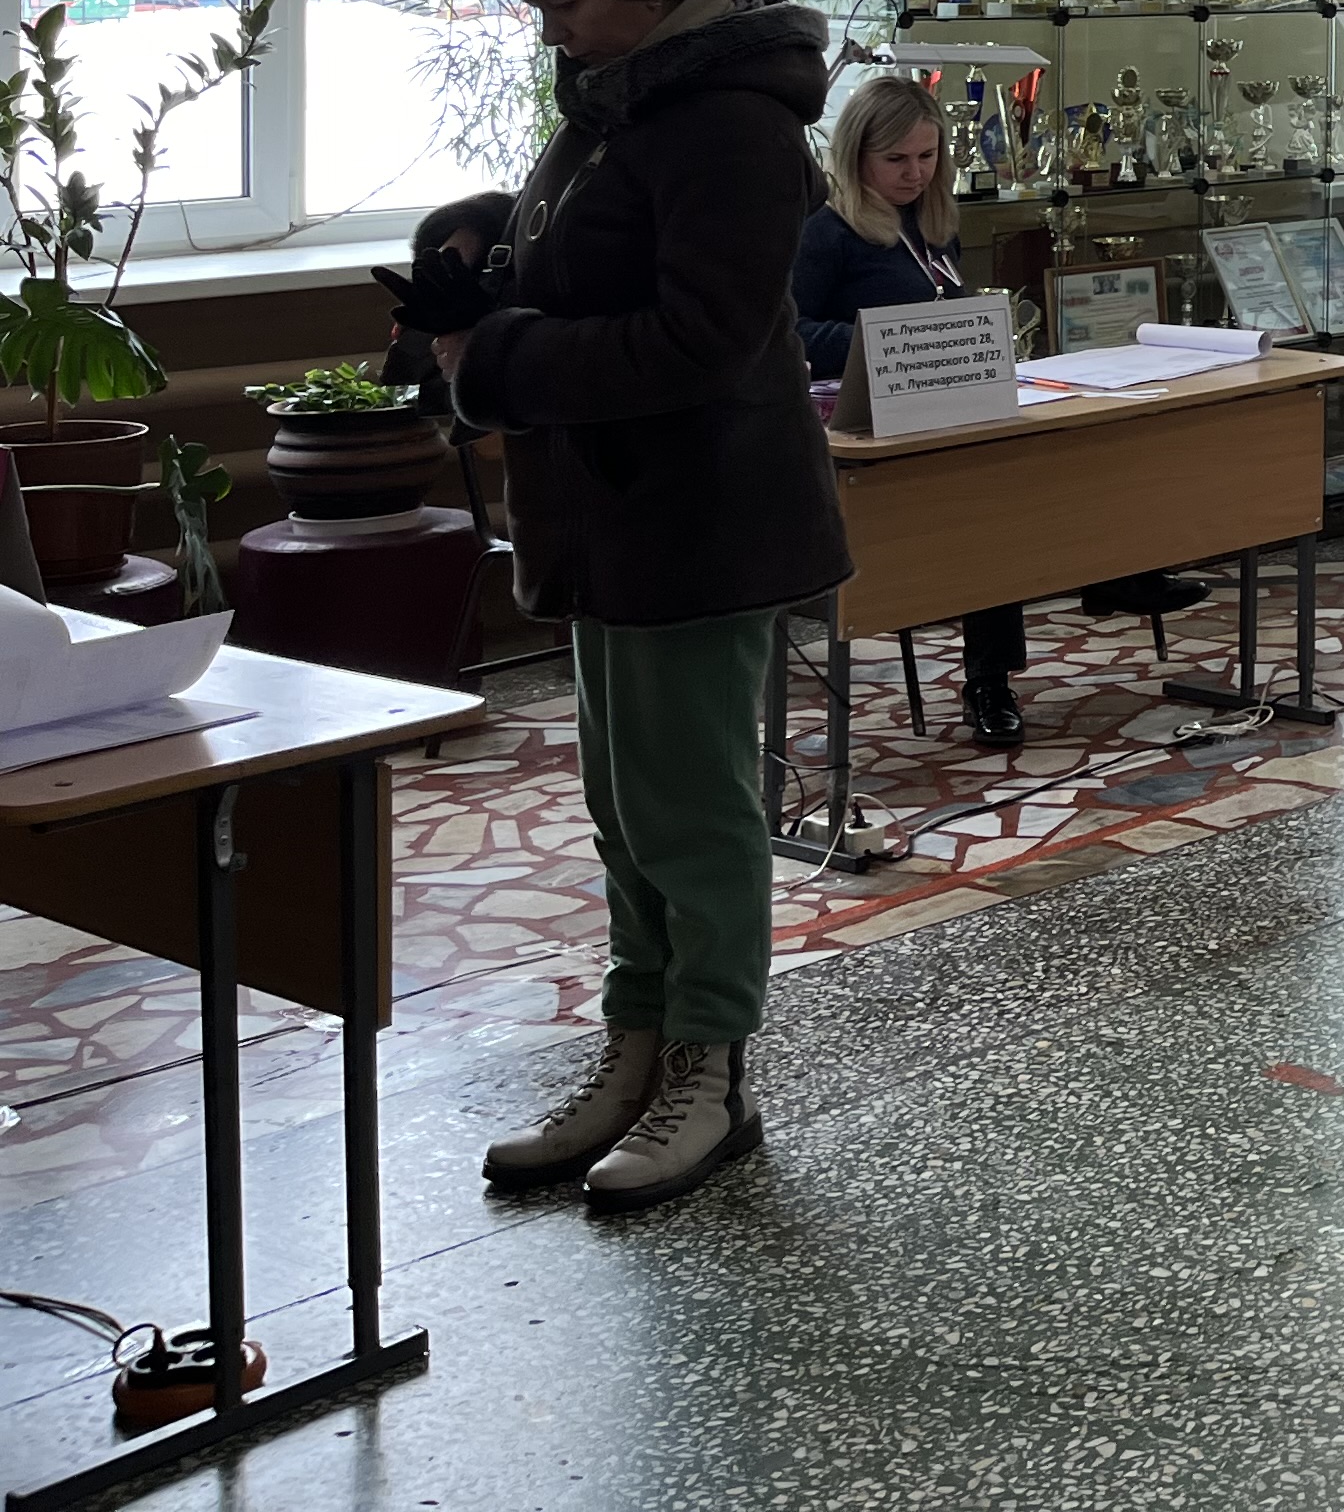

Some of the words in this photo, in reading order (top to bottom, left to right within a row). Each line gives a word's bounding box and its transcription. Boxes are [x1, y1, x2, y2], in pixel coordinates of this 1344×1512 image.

[880, 326, 897, 339] ул.
[900, 320, 974, 337] Луначарского
[976, 315, 993, 327] 7А,
[883, 345, 899, 357] ул.
[902, 336, 976, 354] Луначарского
[979, 333, 995, 345] 28,
[875, 365, 892, 377] ул.
[895, 356, 970, 373] Луначарского
[972, 349, 1005, 364] 28/27,
[888, 382, 904, 394] ул.
[908, 373, 981, 390] Луначарского
[984, 368, 997, 379] 30
